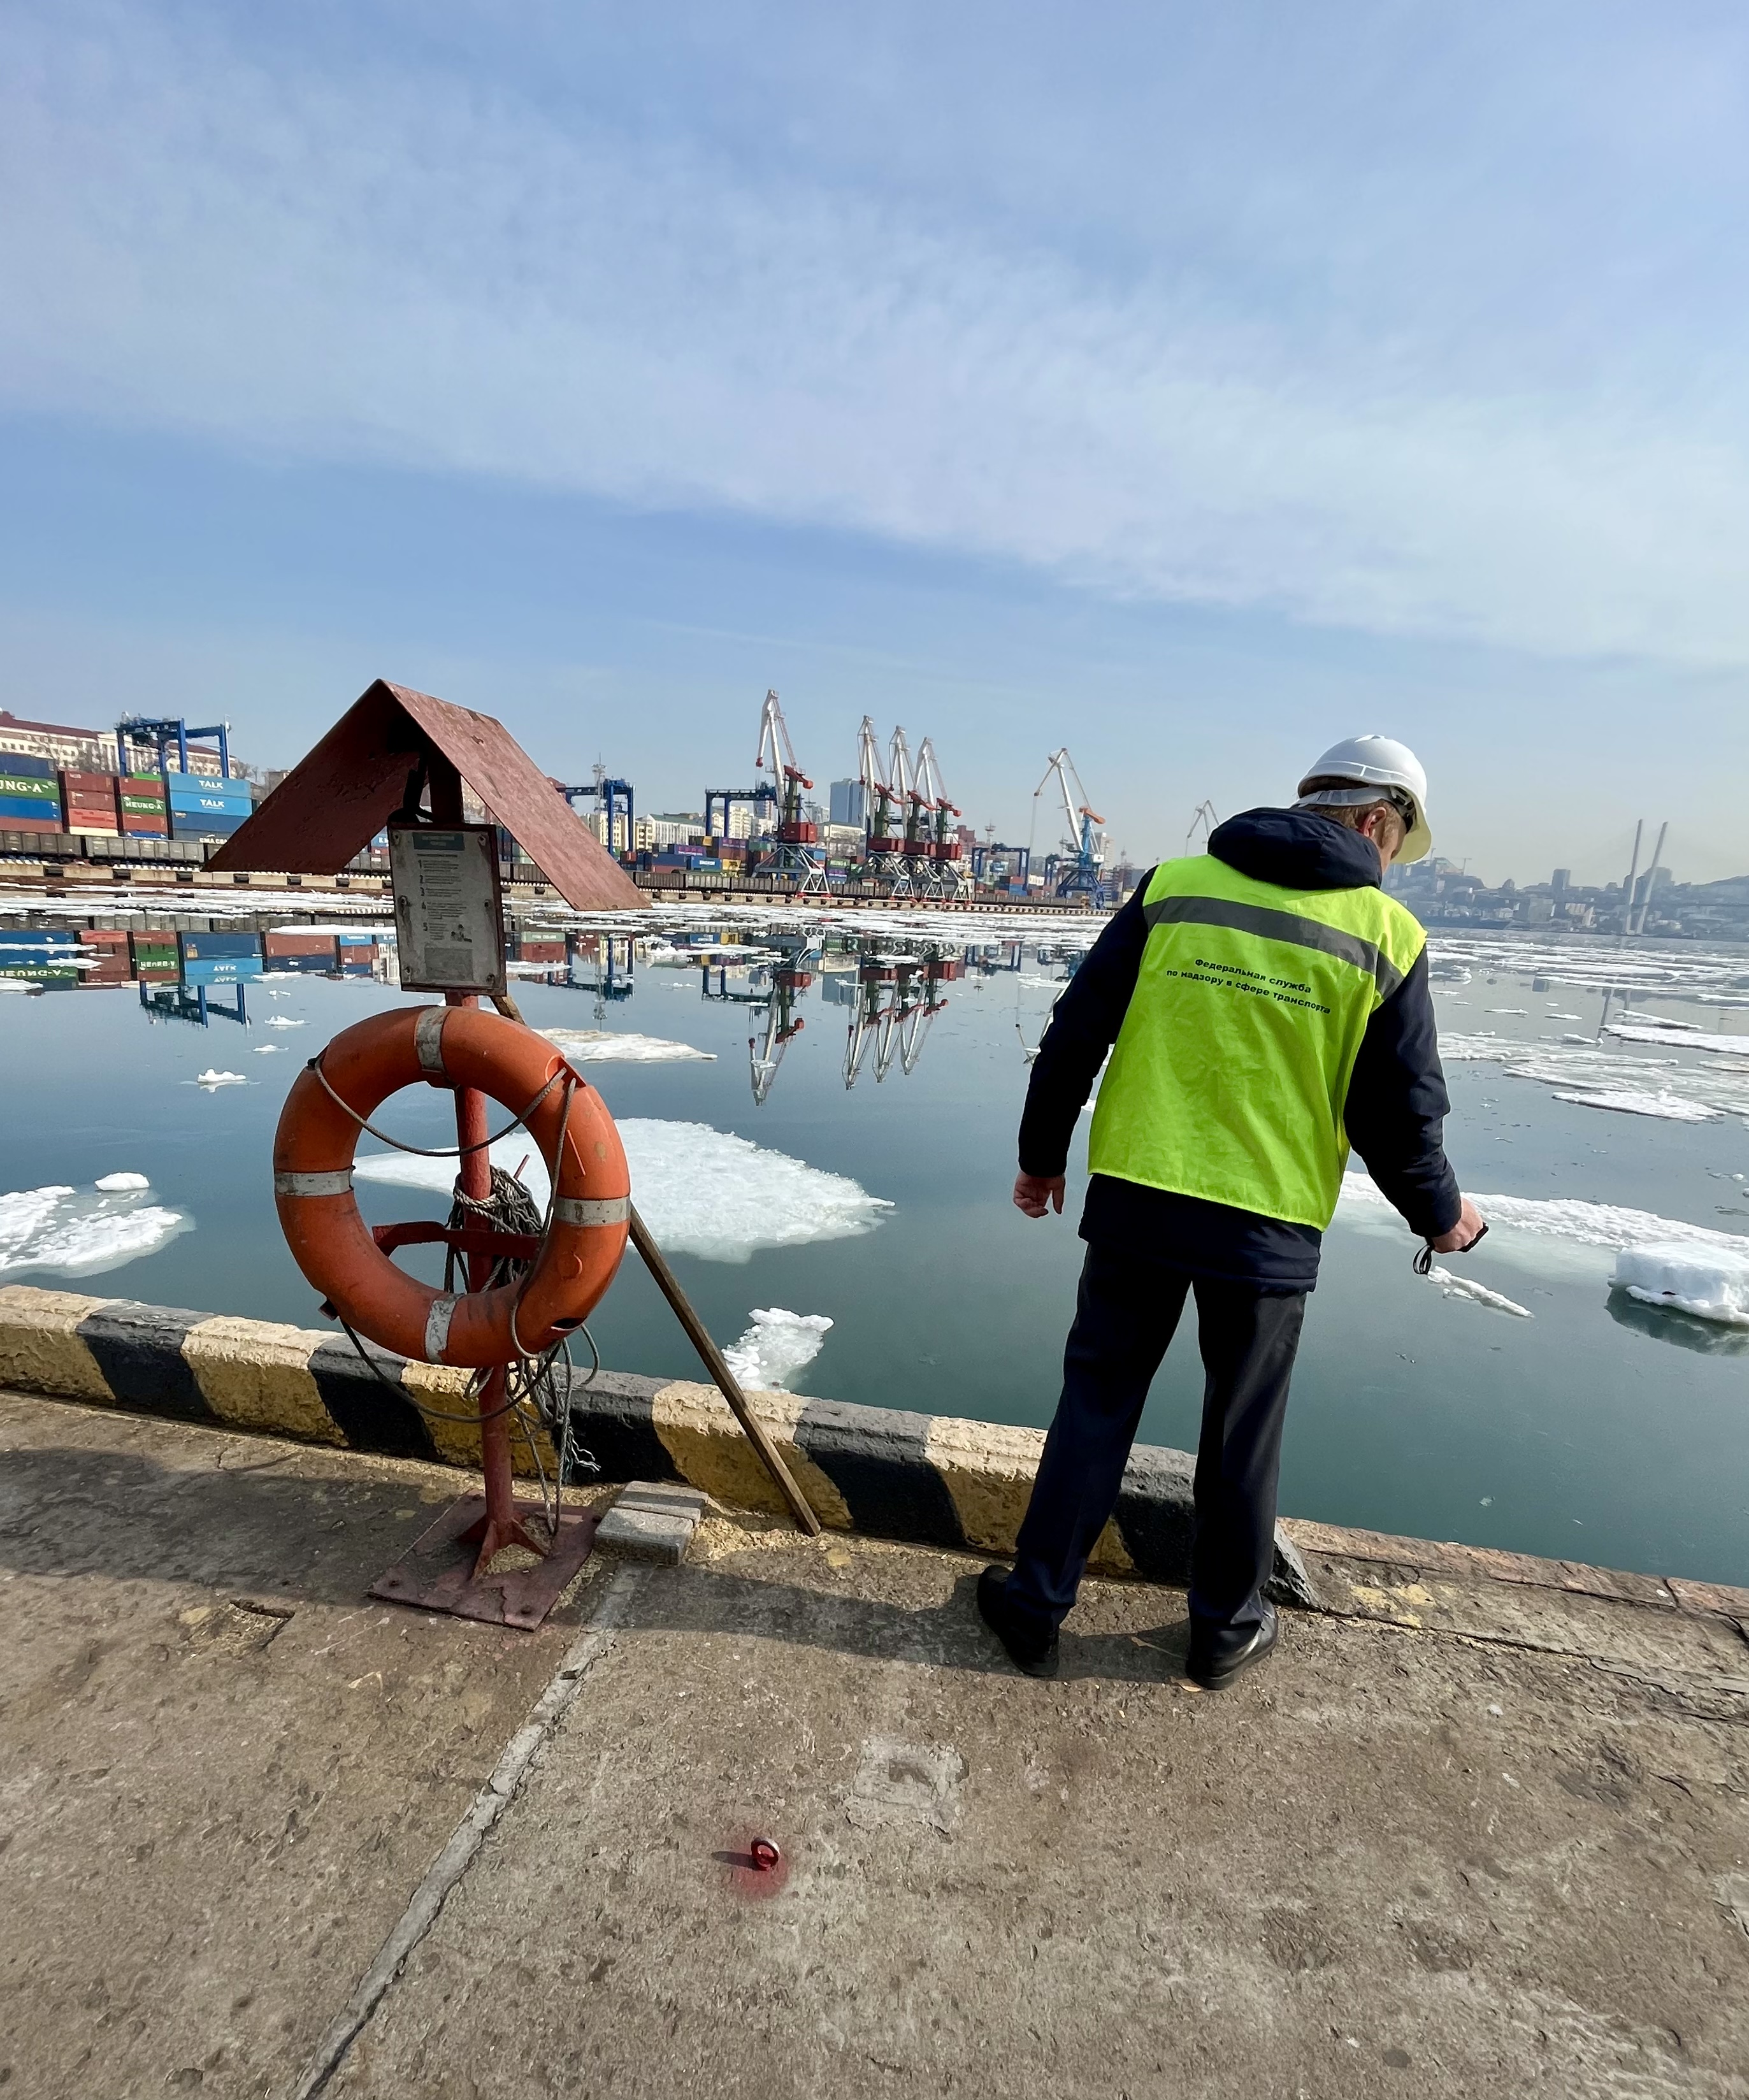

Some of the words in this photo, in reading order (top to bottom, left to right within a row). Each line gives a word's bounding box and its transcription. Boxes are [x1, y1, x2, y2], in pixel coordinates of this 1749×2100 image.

[199, 780, 223, 789] TALK
[126, 801, 162, 810] HEUNG-A
[199, 799, 225, 808] TALK
[1195, 959, 1267, 981] Федеральная
[1269, 978, 1312, 993] служба
[1181, 971, 1224, 986] надзору
[1235, 982, 1270, 996] сфере
[1273, 991, 1331, 1014] транспорта
